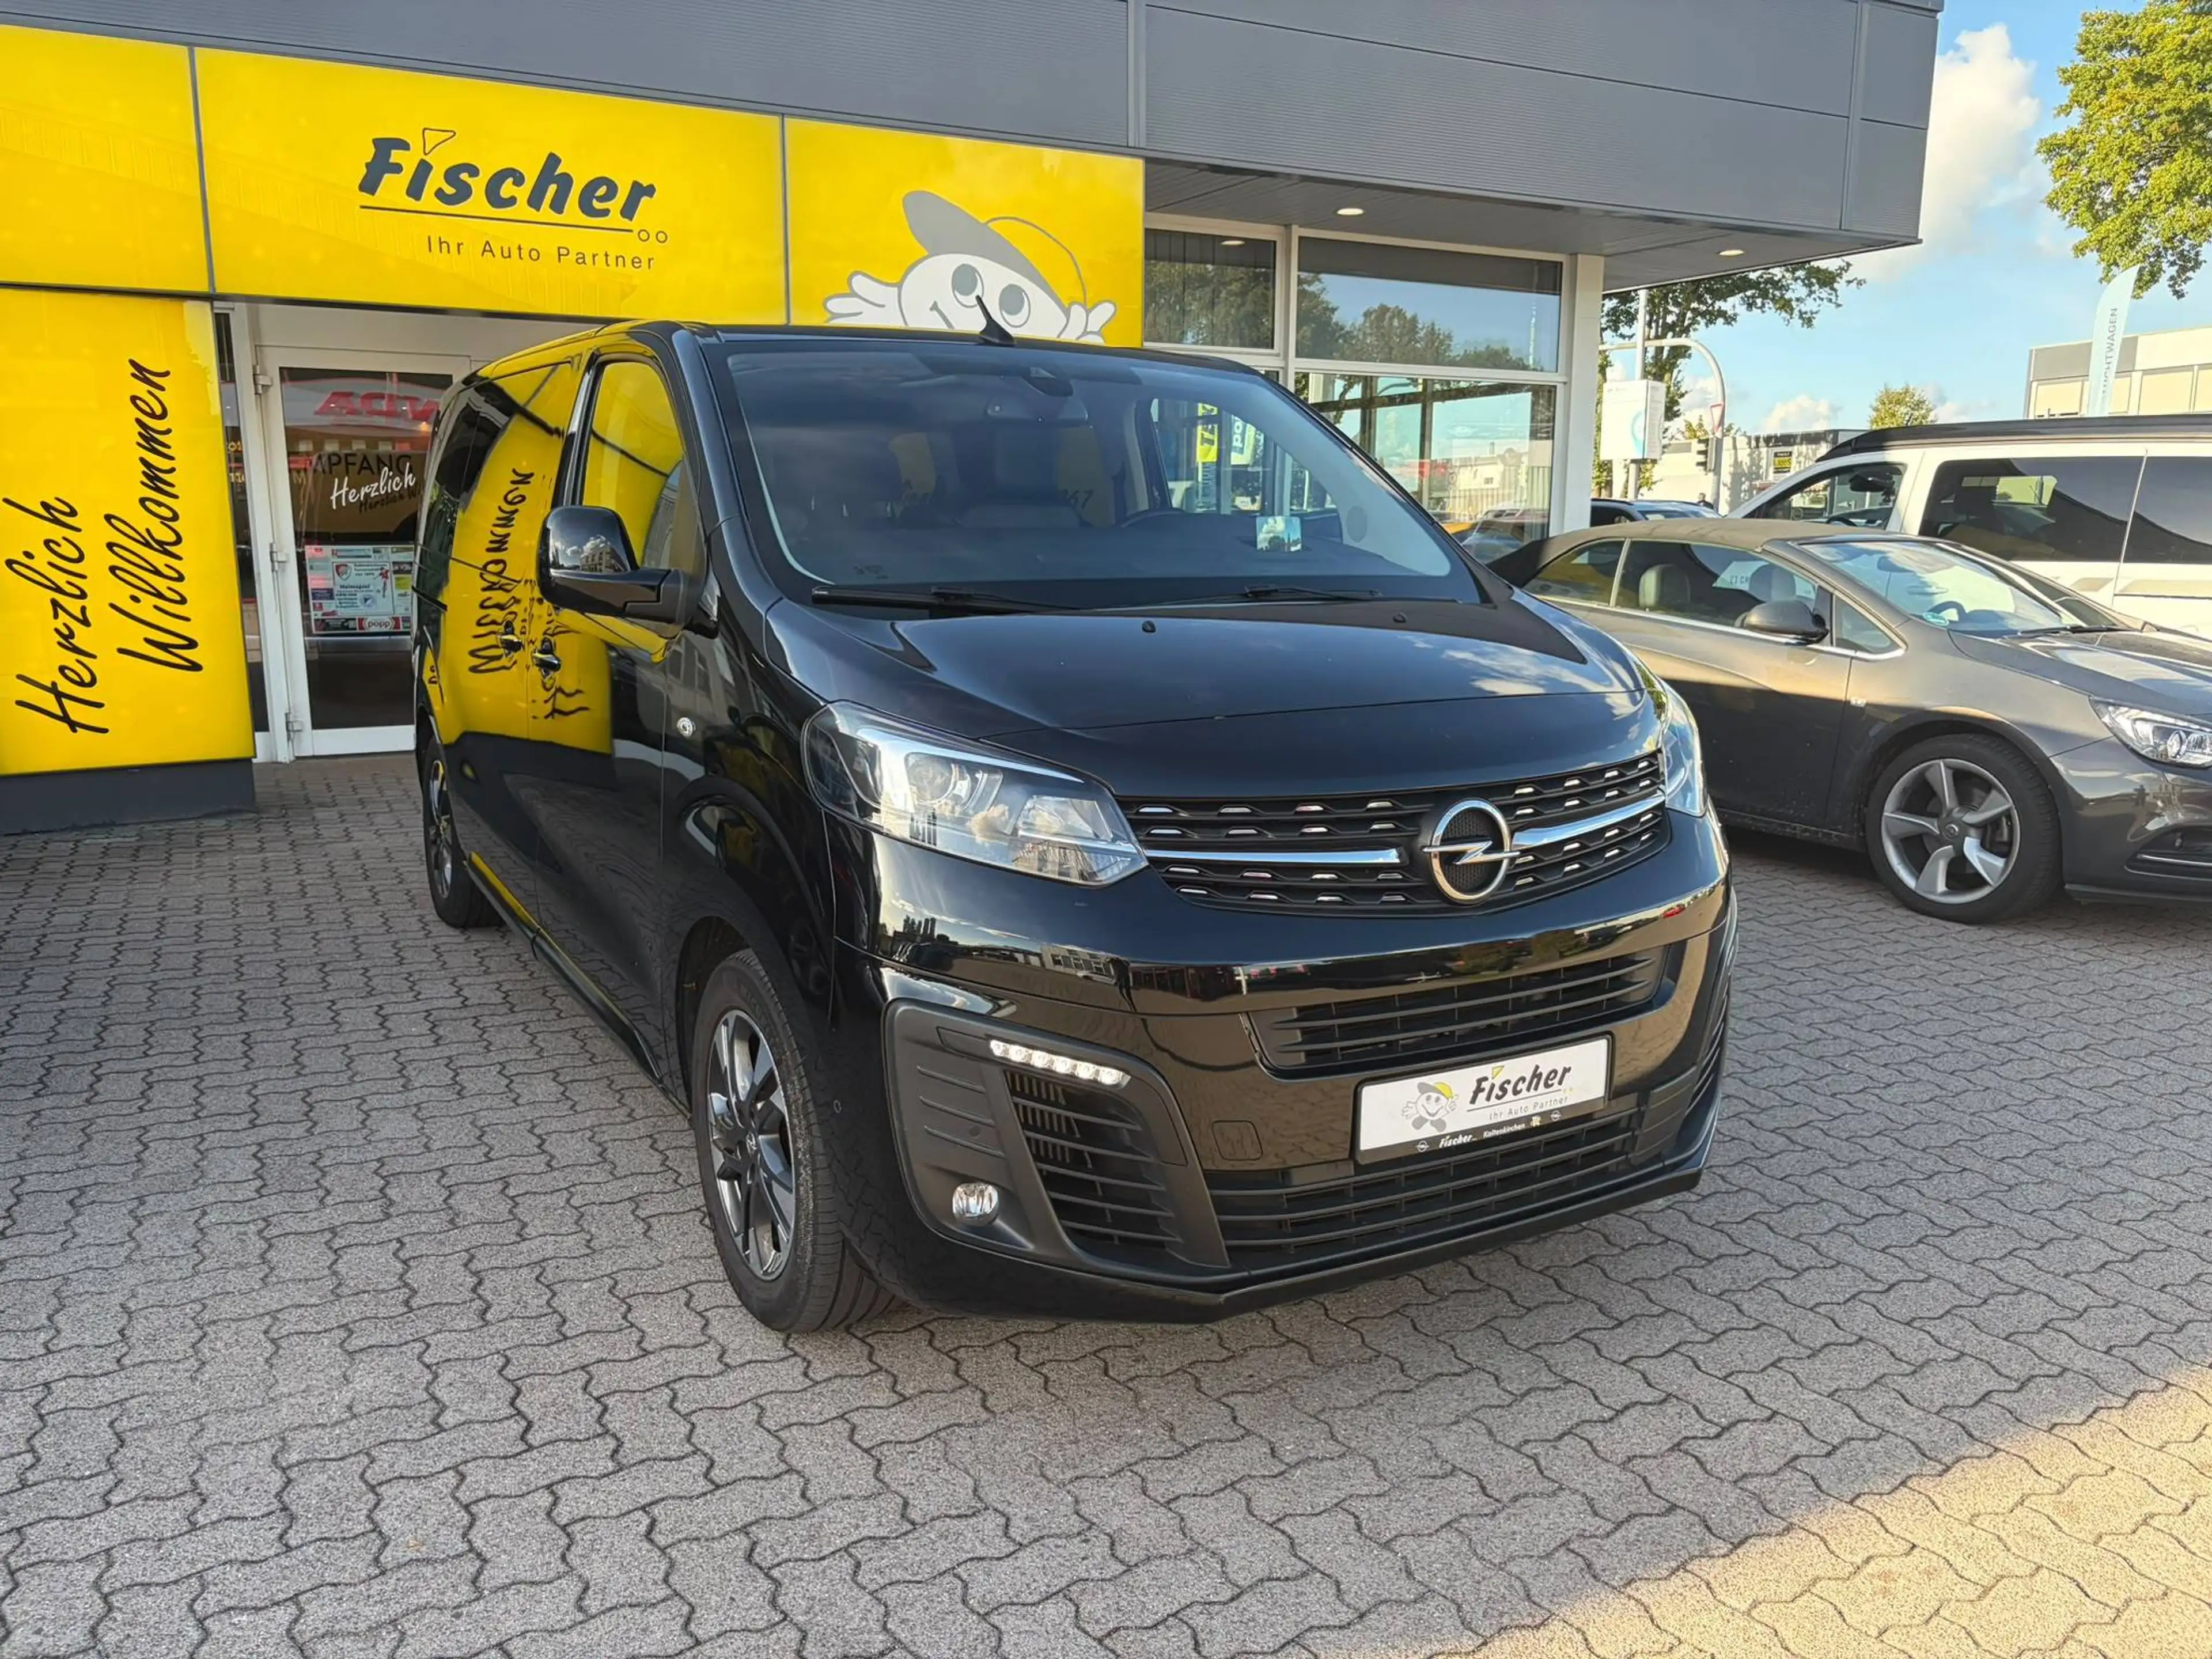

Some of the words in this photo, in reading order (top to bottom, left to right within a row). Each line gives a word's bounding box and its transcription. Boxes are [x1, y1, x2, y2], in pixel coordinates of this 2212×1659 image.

[358, 129, 656, 221] Fischer
[427, 236, 464, 255] Ihr
[481, 240, 540, 261] Auto
[558, 247, 654, 270] Partner
[330, 462, 416, 510] Herzlich
[104, 358, 203, 672] Willkommen
[2, 496, 109, 733] Herzlich
[1469, 1064, 1572, 1104] Fischer
[1489, 1111, 1503, 1120] Ihr
[1508, 1105, 1529, 1115] Auto
[1533, 1096, 1568, 1110] Partner
[1439, 1134, 1473, 1148] Fischer
